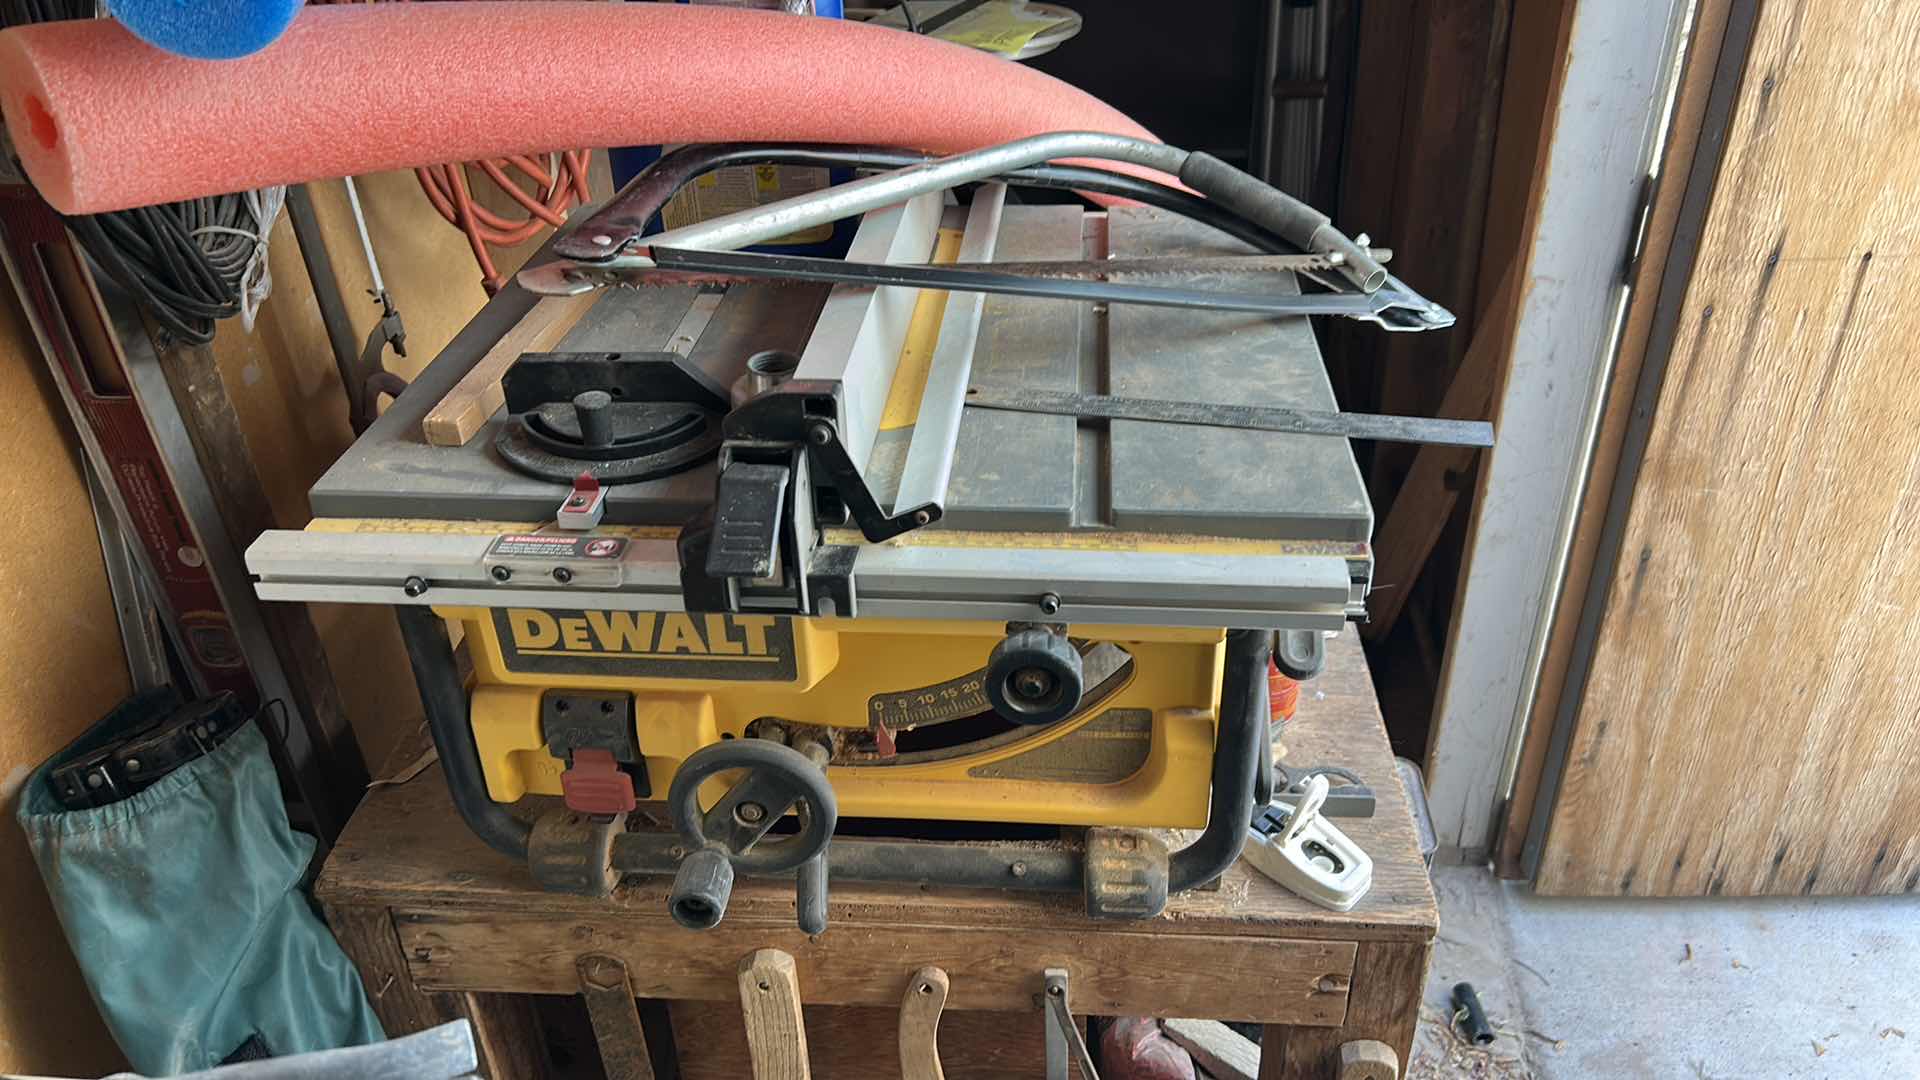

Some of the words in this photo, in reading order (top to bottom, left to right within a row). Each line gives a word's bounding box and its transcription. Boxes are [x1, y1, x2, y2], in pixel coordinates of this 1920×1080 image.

[874, 701, 884, 711] 0
[897, 698, 908, 708] 5
[917, 693, 935, 705] 10
[940, 687, 959, 700] 15
[961, 680, 981, 693] 20
